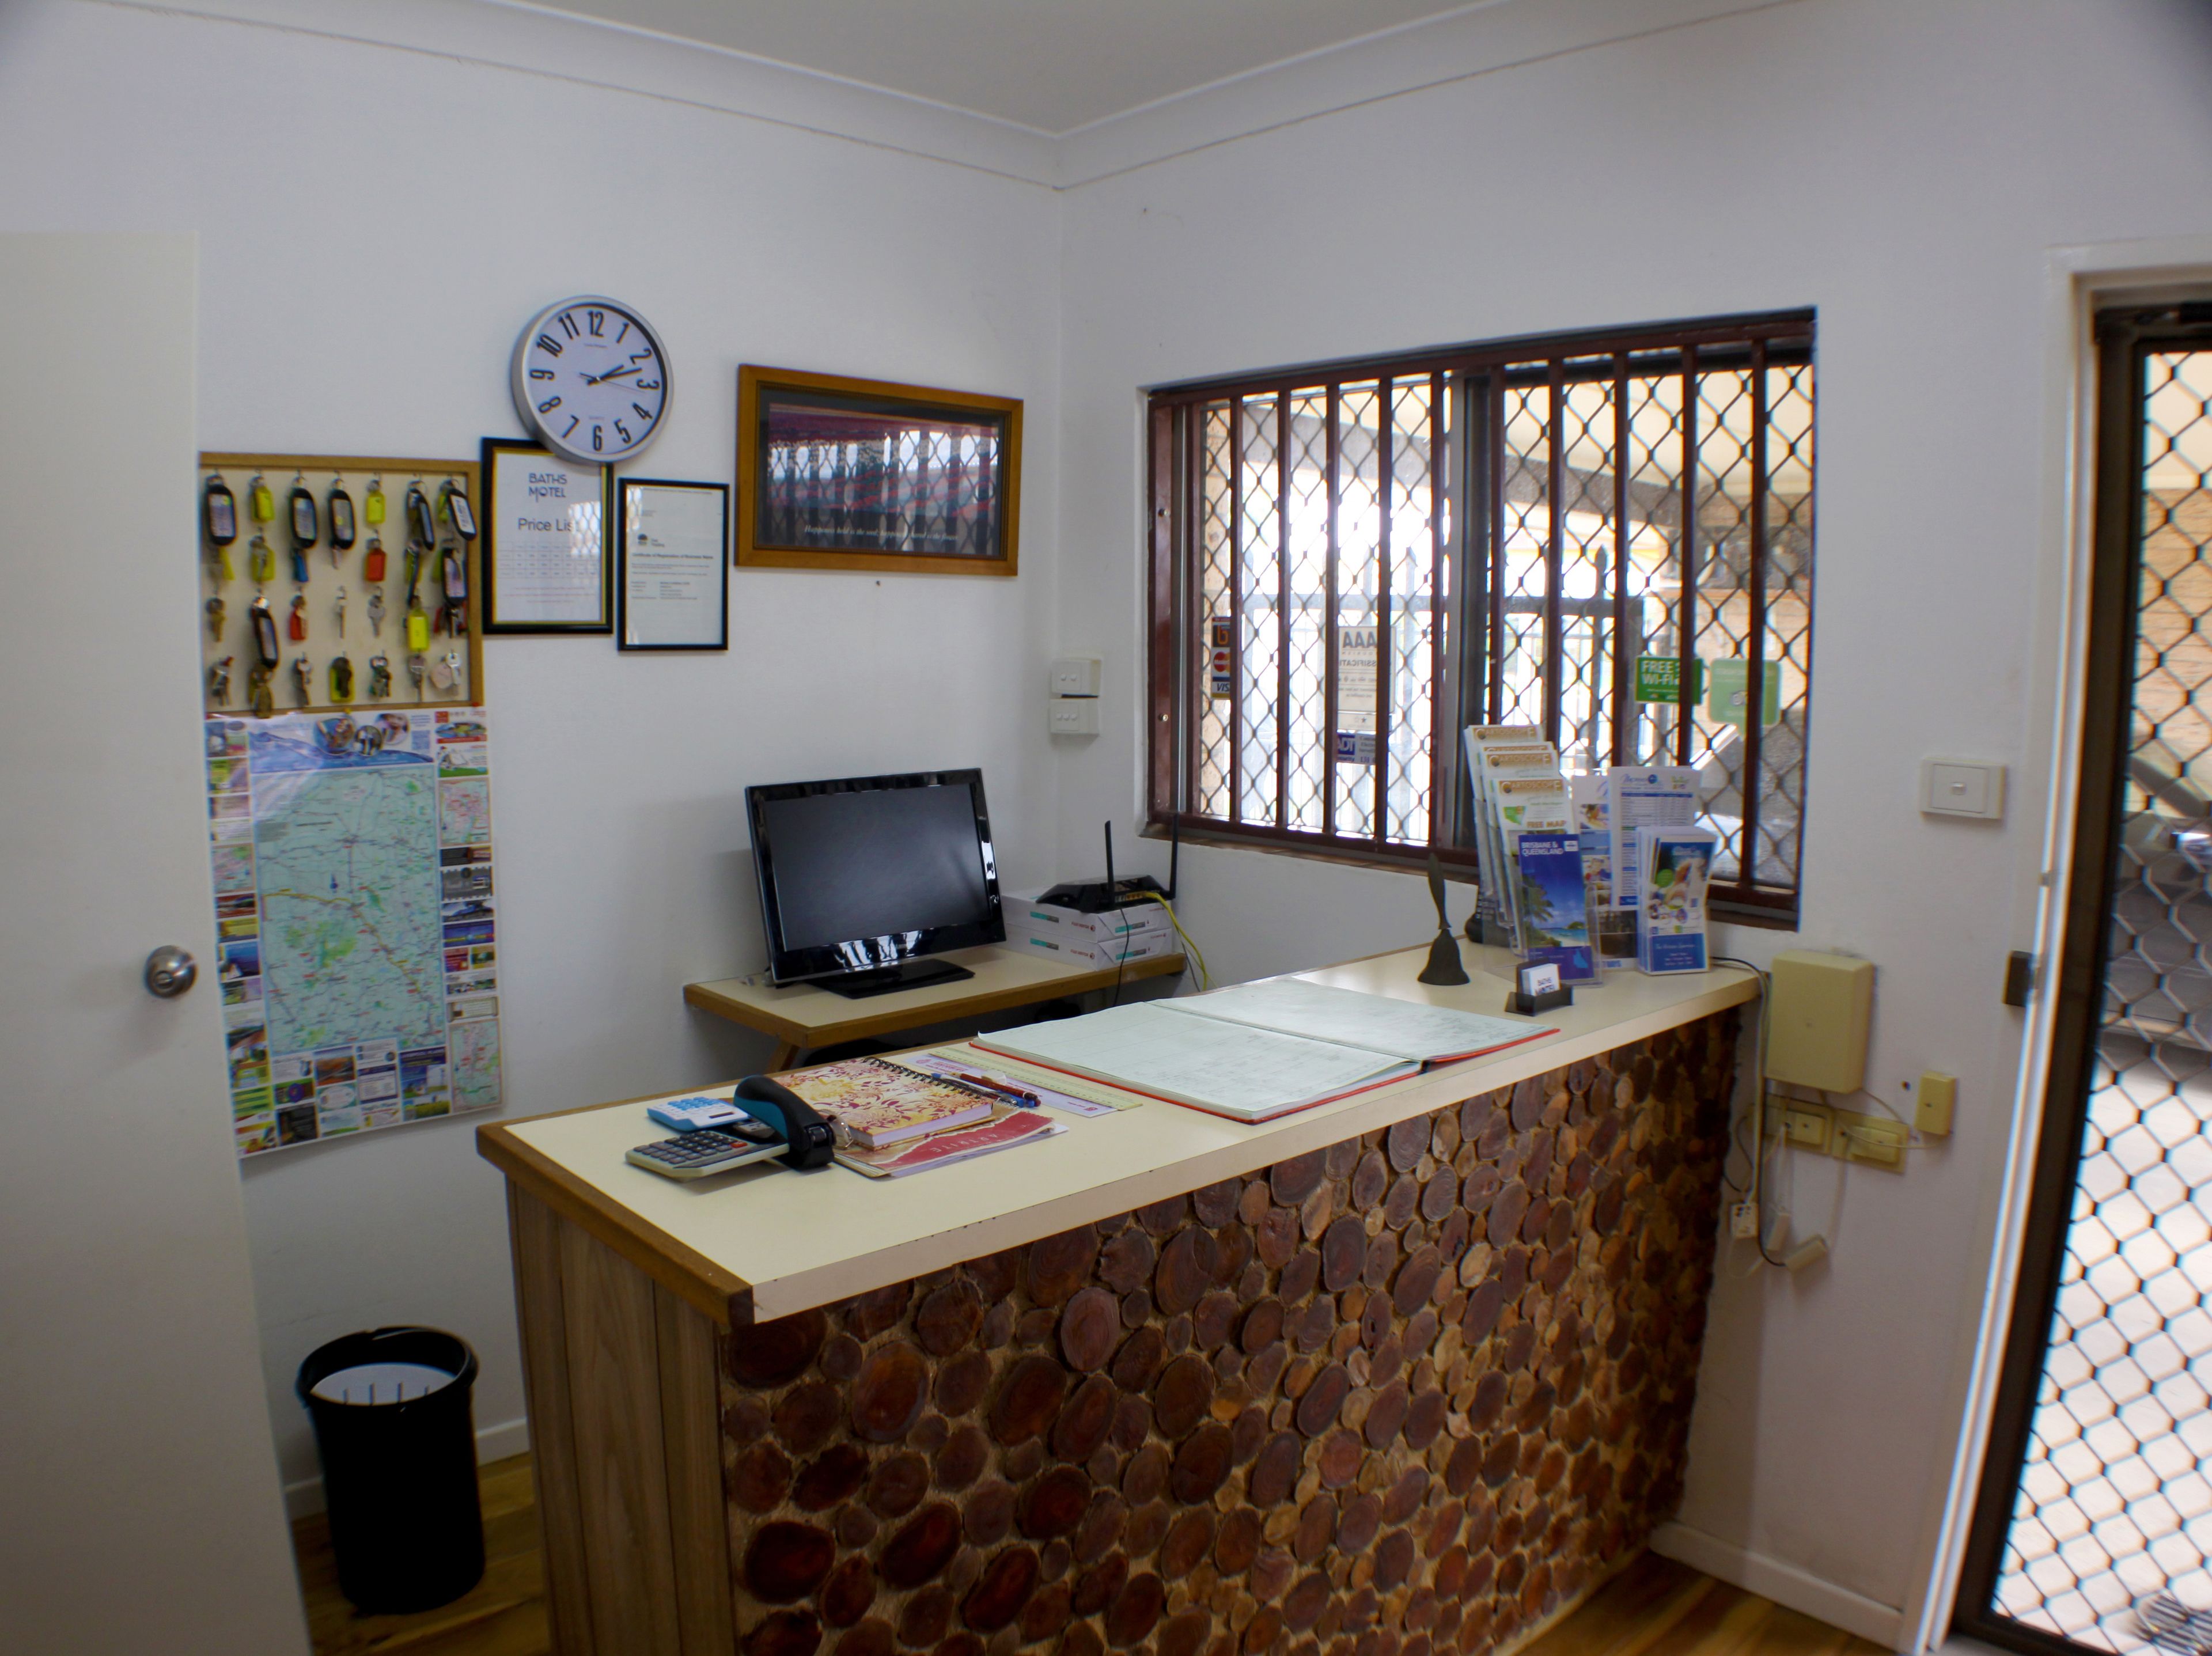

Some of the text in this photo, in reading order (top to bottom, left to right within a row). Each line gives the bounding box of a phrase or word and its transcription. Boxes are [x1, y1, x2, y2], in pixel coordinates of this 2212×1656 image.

[558, 312, 580, 340] 11
[588, 310, 604, 338] 12
[616, 321, 630, 344] 1
[536, 334, 563, 357] 10
[630, 347, 652, 365] 2
[529, 369, 555, 380] 9
[636, 379, 660, 391] 3
[538, 396, 562, 414] 8
[632, 402, 653, 420] 4
[562, 415, 580, 438] 7
[614, 419, 631, 444] 5
[593, 425, 603, 452] 6
[529, 473, 567, 484] BATHS
[528, 487, 566, 502] MOTEL
[518, 518, 551, 531] Price
[1641, 661, 1673, 673] FREE
[1217, 683, 1230, 692] VIS
[1502, 780, 1561, 793] CARTOSCOPE
[1522, 848, 1563, 857] QUEENSLAND
